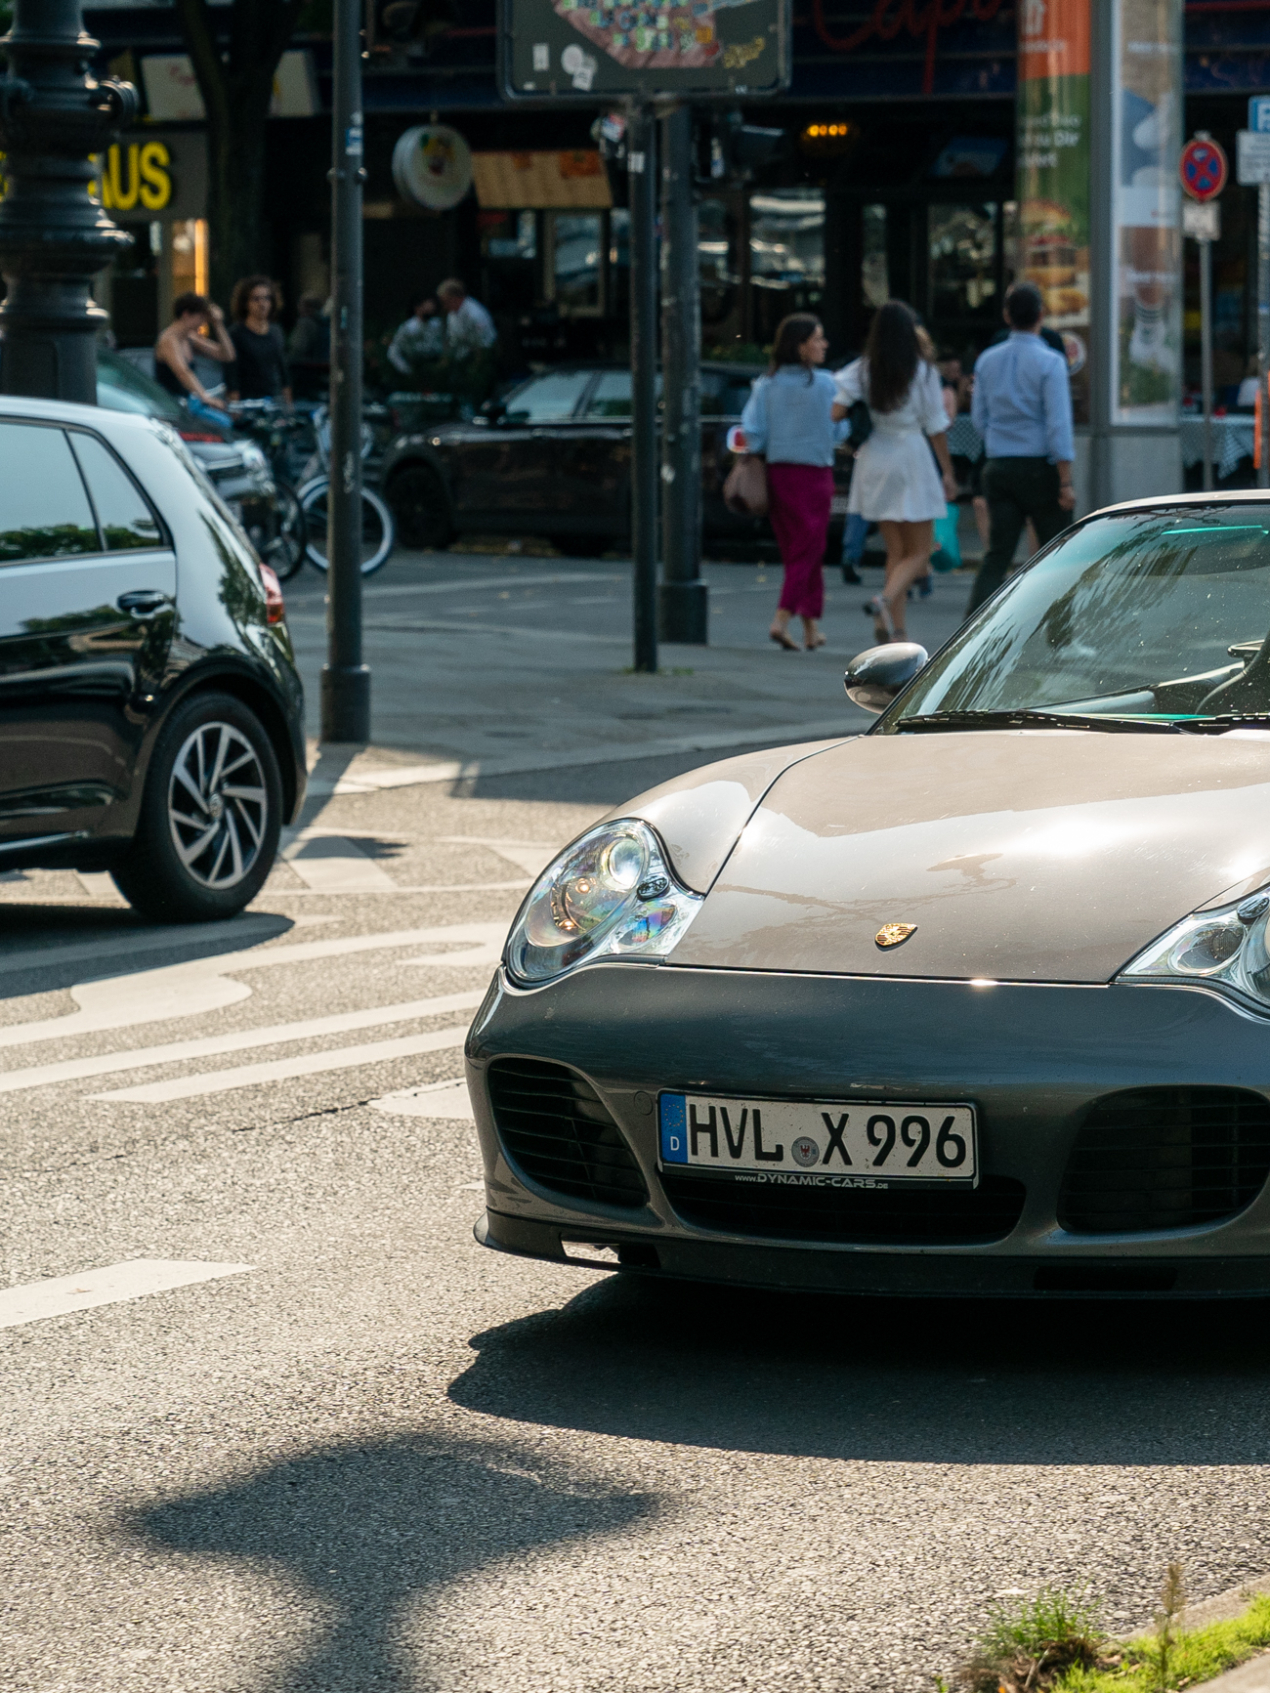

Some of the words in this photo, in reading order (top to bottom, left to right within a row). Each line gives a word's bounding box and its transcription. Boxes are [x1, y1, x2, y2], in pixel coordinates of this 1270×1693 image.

[670, 1136, 680, 1151] D
[688, 1103, 784, 1162] HVL
[820, 1111, 853, 1166] X
[866, 1113, 967, 1169] 996
